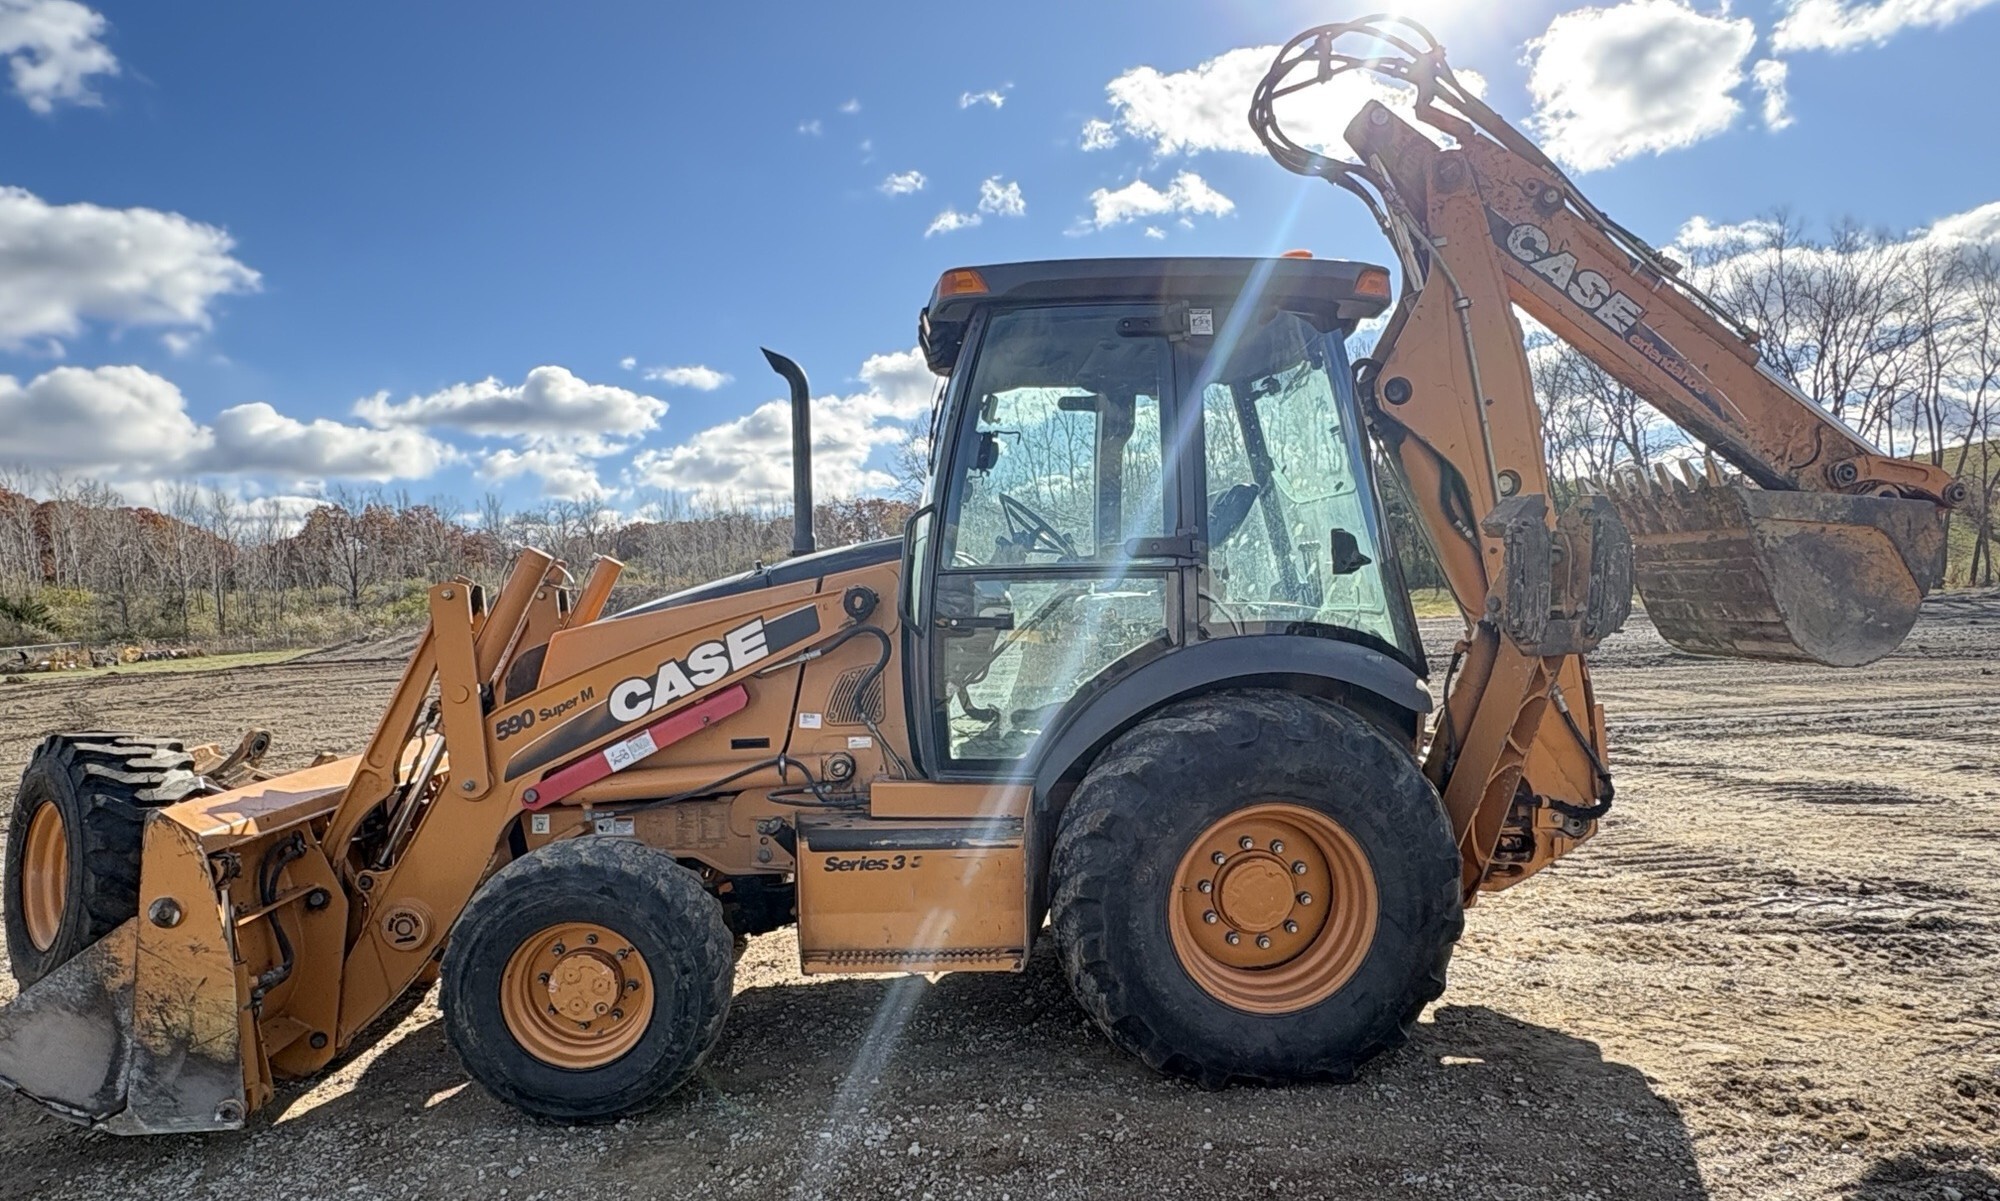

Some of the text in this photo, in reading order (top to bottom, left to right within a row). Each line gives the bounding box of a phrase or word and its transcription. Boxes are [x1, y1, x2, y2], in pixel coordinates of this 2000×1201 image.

[1506, 224, 1645, 332] CASE
[1629, 332, 1706, 395] extendahoe
[609, 618, 769, 722] CASE
[496, 686, 595, 741] 590 Super M
[823, 855, 889, 872] Series
[891, 854, 906, 870] 3
